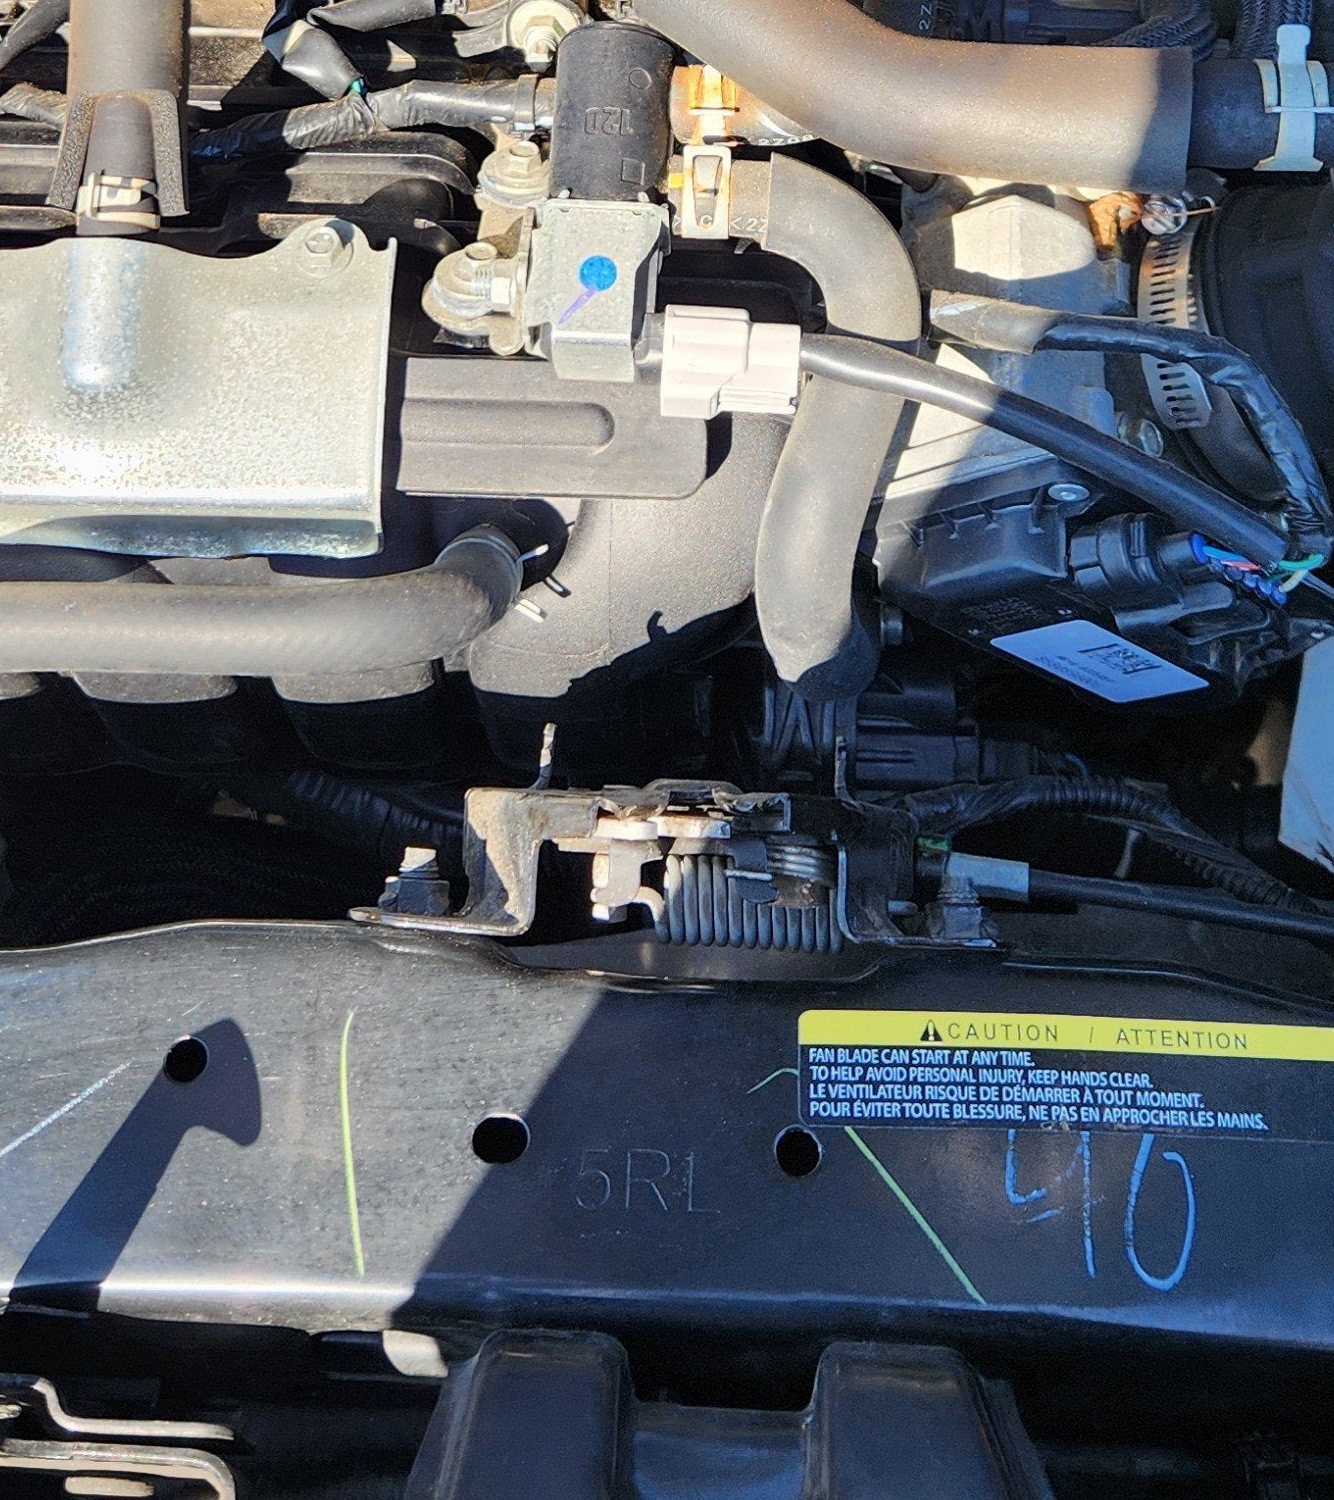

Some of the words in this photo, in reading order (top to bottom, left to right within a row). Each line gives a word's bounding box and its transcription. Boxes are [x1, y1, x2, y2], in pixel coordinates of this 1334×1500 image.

[948, 1023, 1058, 1042] CAUTION
[1117, 1028, 1247, 1050] ATTENTION
[809, 1048, 834, 1063] FAN
[837, 1049, 879, 1064] BLADE
[881, 1049, 909, 1065] CAN
[911, 1050, 950, 1065] START
[952, 1051, 969, 1066] AT
[971, 1051, 998, 1066] ANY
[1000, 1051, 1035, 1067] TIME.
[810, 1066, 828, 1081] TO
[831, 1066, 863, 1081] HELP
[866, 1067, 906, 1082] AVOID
[909, 1067, 977, 1083] PERSONAL
[979, 1068, 1026, 1086] INJURY,
[1028, 1070, 1058, 1084] KEEP
[1062, 1071, 1107, 1087] HANDS
[1109, 1072, 1153, 1088] CLEAR.
[810, 1084, 827, 1099] LE
[828, 1084, 922, 1100] VENTILATEUR
[925, 1085, 977, 1101] RISQUE
[980, 1086, 999, 1100] DE
[1001, 1082, 1082, 1103] DÉMARRER
[1083, 1085, 1093, 1103] À
[1095, 1089, 1134, 1105] TOUT
[1137, 1091, 1205, 1108] MOMENT.
[809, 1102, 851, 1117] POUR
[853, 1099, 902, 1118] ÉVITER
[904, 1103, 950, 1118] TOUTE
[953, 1104, 1026, 1122] BLESSURE,
[1029, 1106, 1049, 1120] NE
[1052, 1106, 1077, 1121] PAS
[1081, 1107, 1100, 1122] EN
[1103, 1107, 1188, 1126] APPROCHER
[1191, 1111, 1215, 1127] LES
[1217, 1112, 1269, 1130] MAINS.
